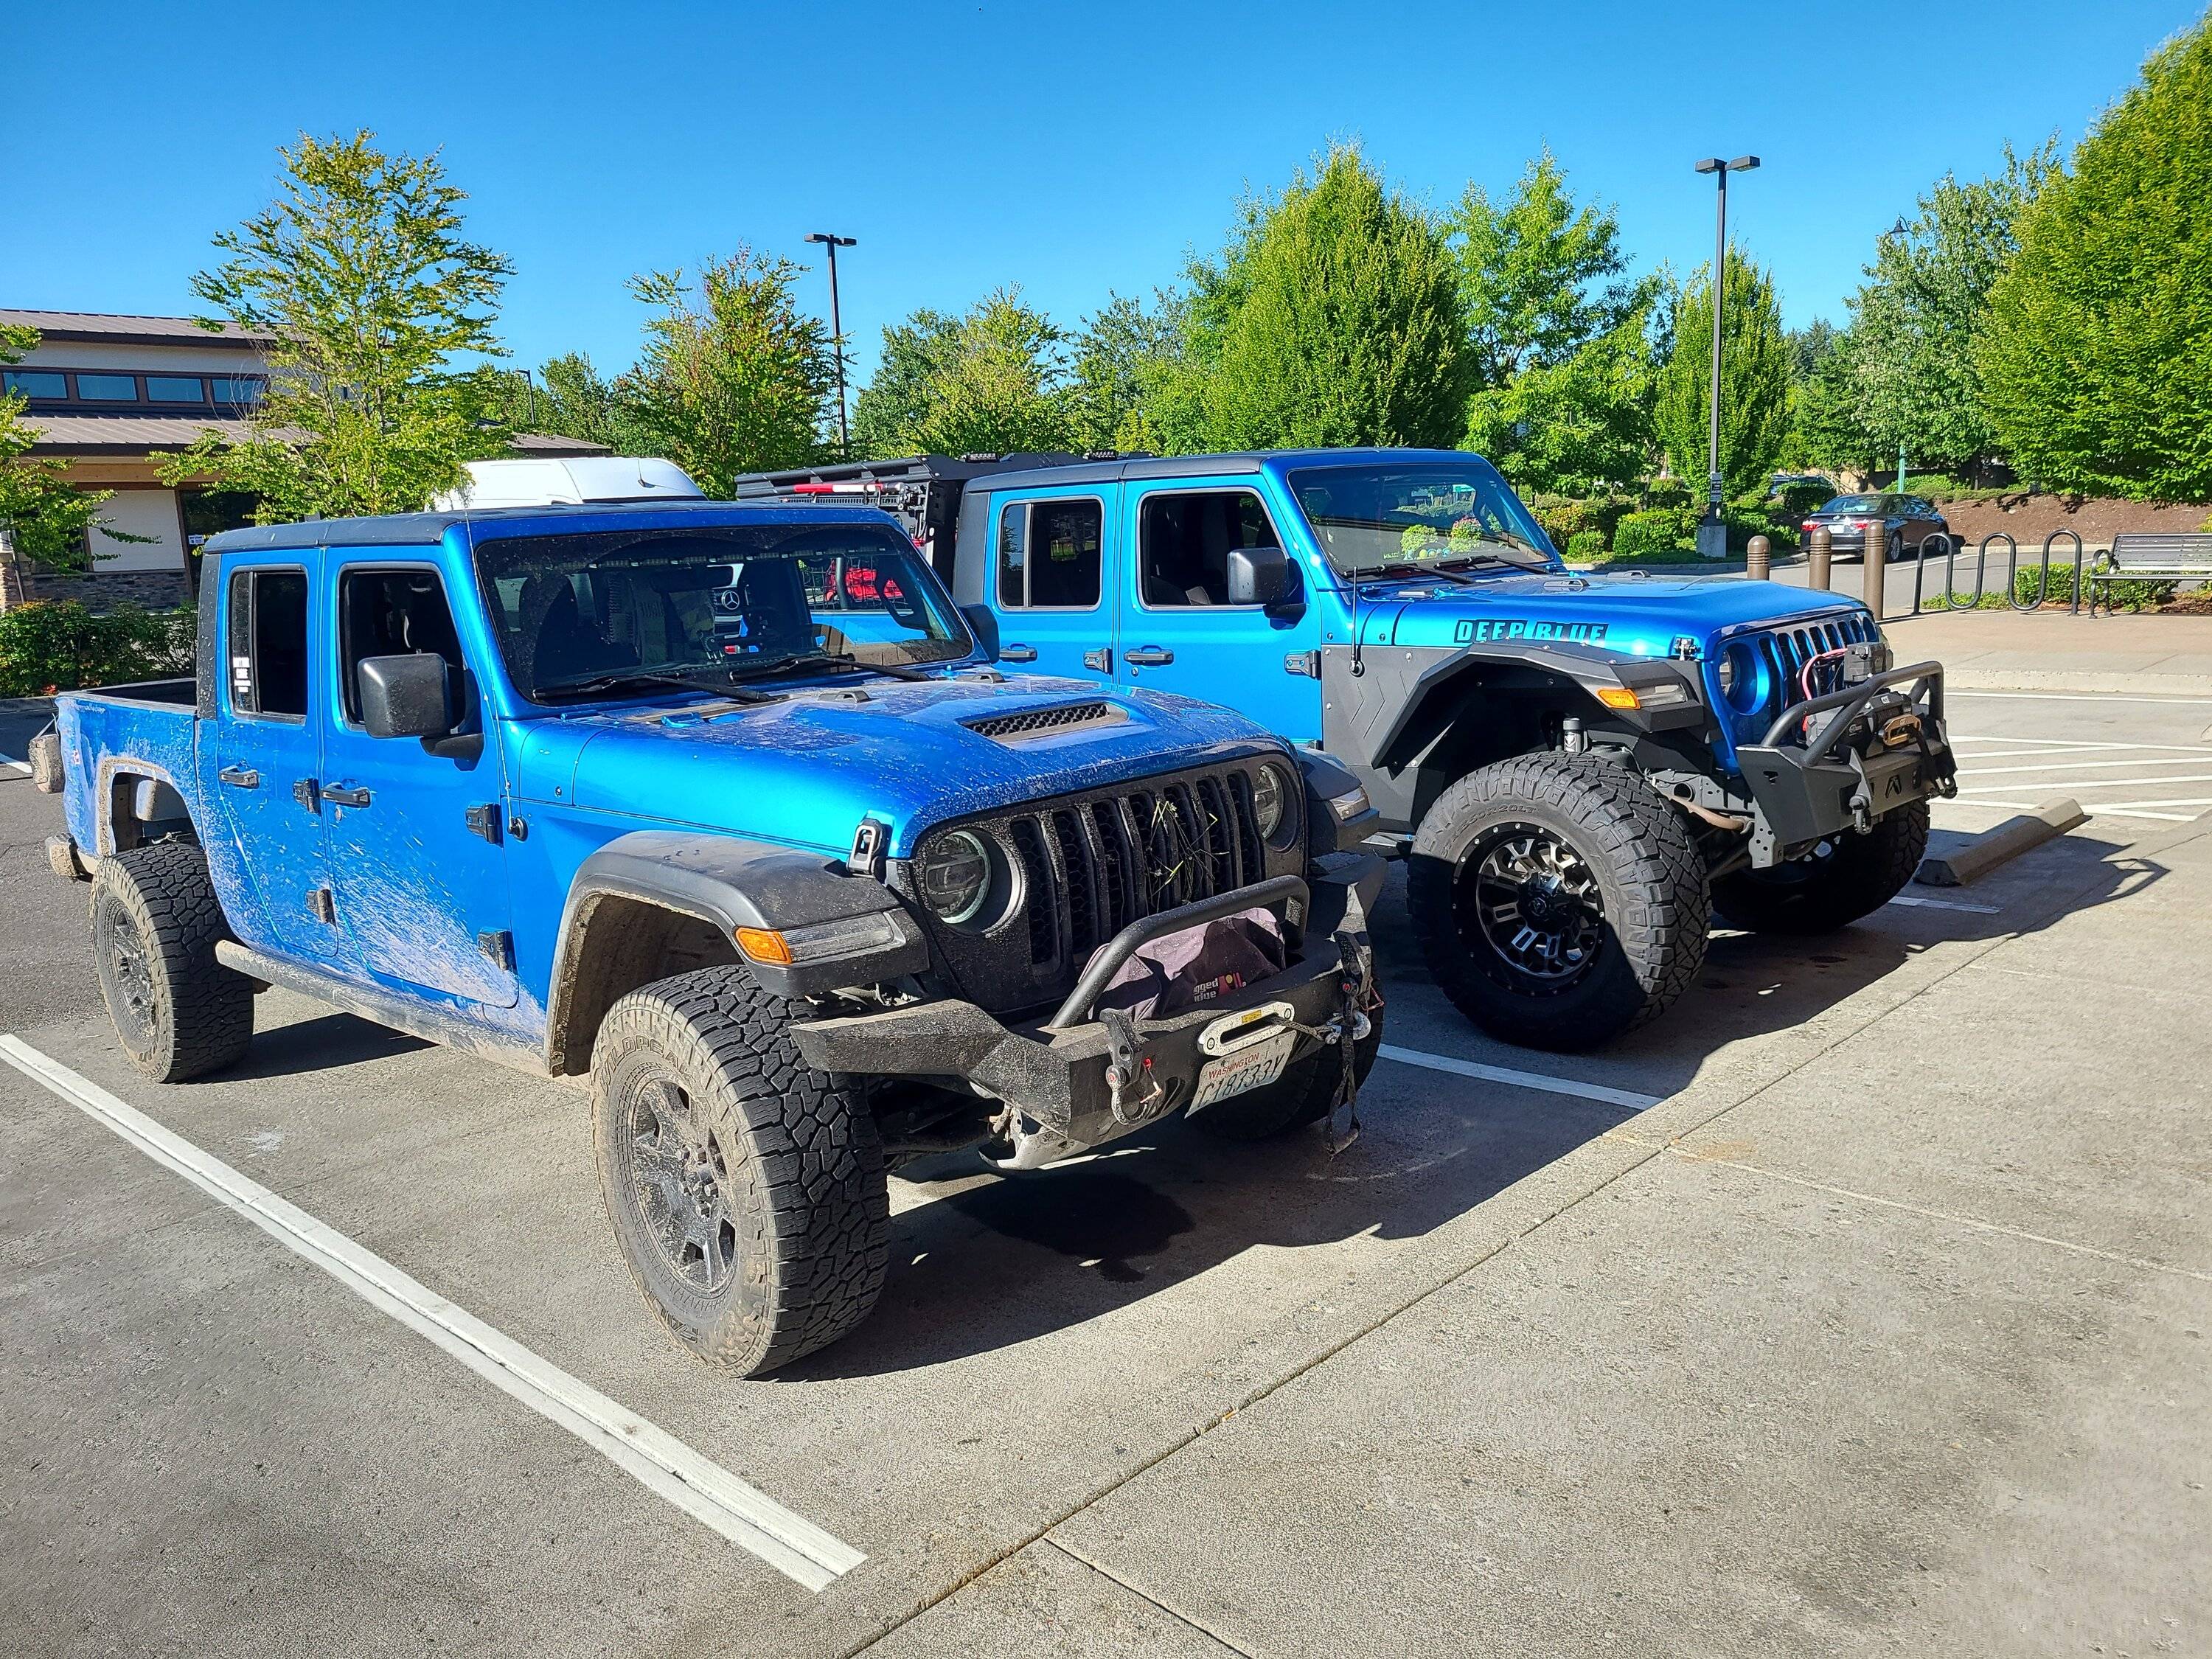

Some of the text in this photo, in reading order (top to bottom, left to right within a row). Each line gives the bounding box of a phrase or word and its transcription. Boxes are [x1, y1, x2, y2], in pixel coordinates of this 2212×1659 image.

[1455, 620, 1608, 642] DEEP BLUE
[1209, 1053, 1259, 1079] WASHINGTON
